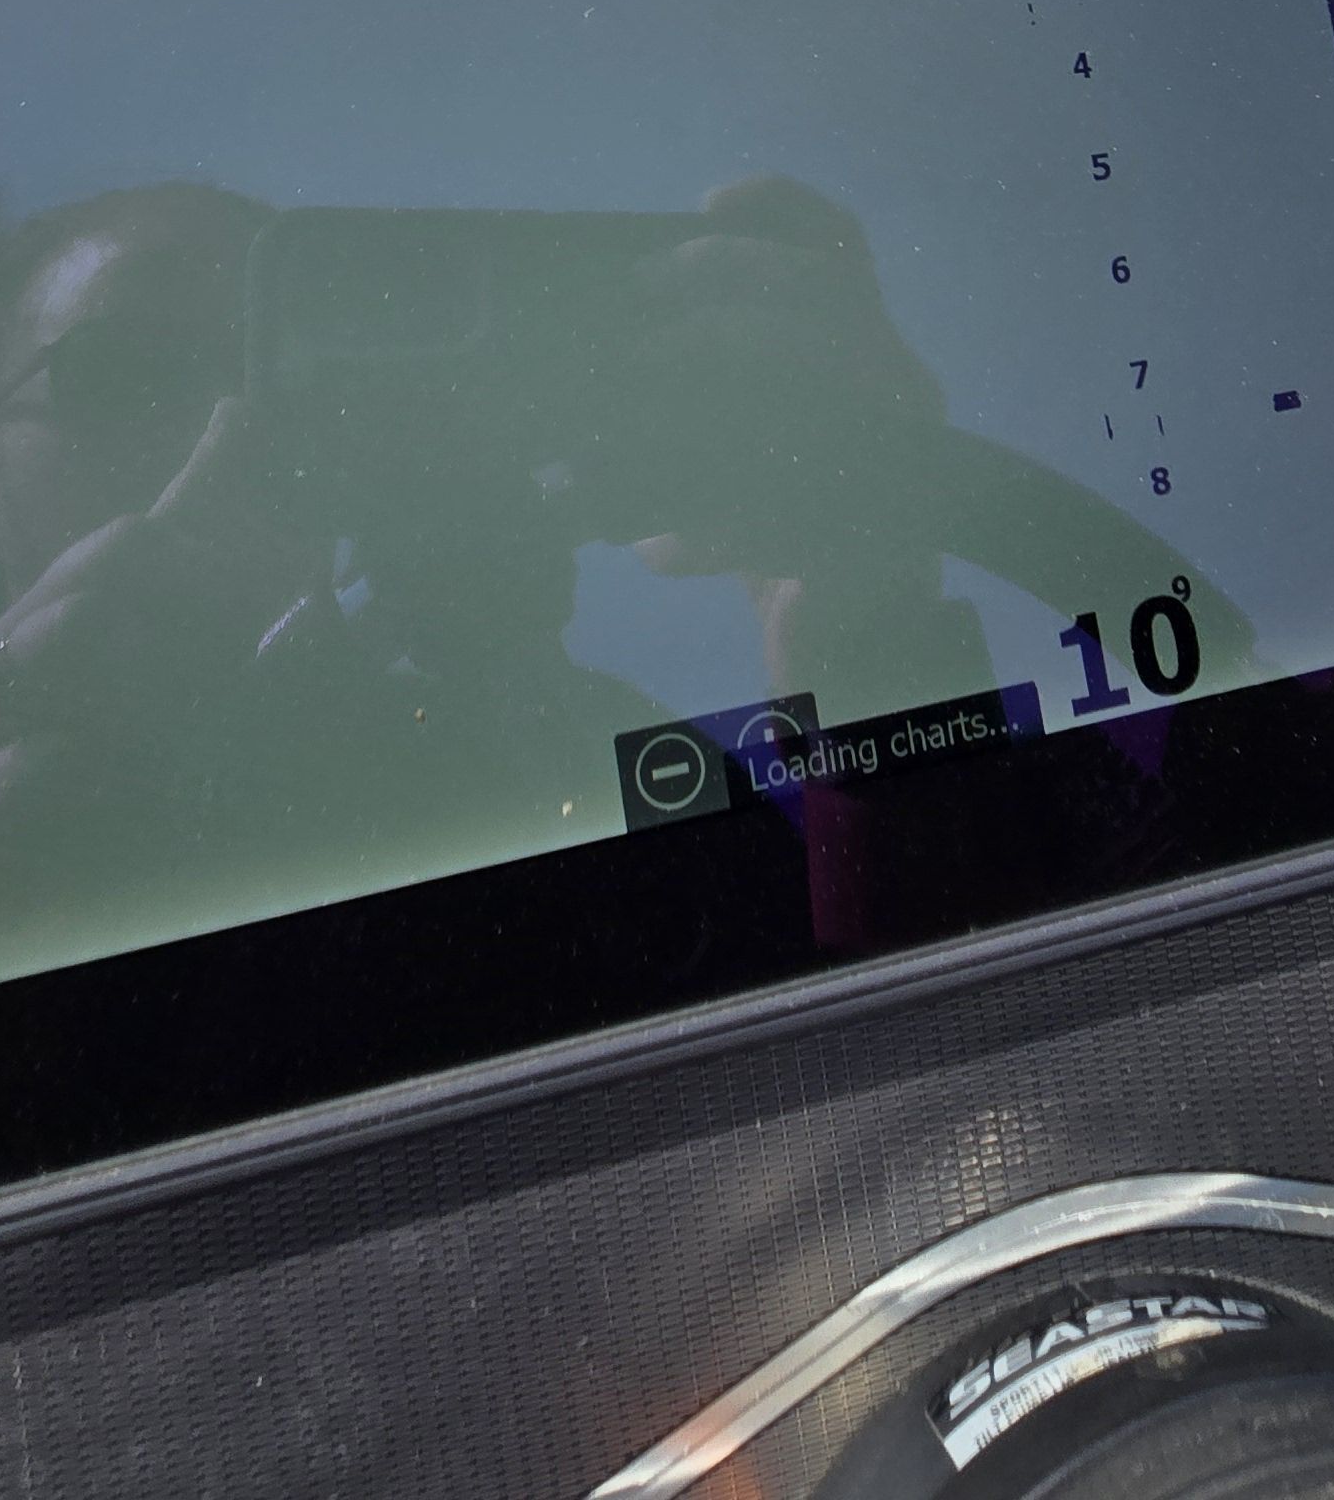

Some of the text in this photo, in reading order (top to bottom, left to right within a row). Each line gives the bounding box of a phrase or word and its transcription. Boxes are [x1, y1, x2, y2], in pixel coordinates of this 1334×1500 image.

[1074, 52, 1092, 79] 4
[1091, 153, 1112, 180] 5
[1110, 256, 1131, 284] 6
[1129, 360, 1149, 390] 7
[1150, 467, 1171, 495] 8
[1059, 594, 1201, 717] 10
[748, 711, 1019, 791] Loading charts...
